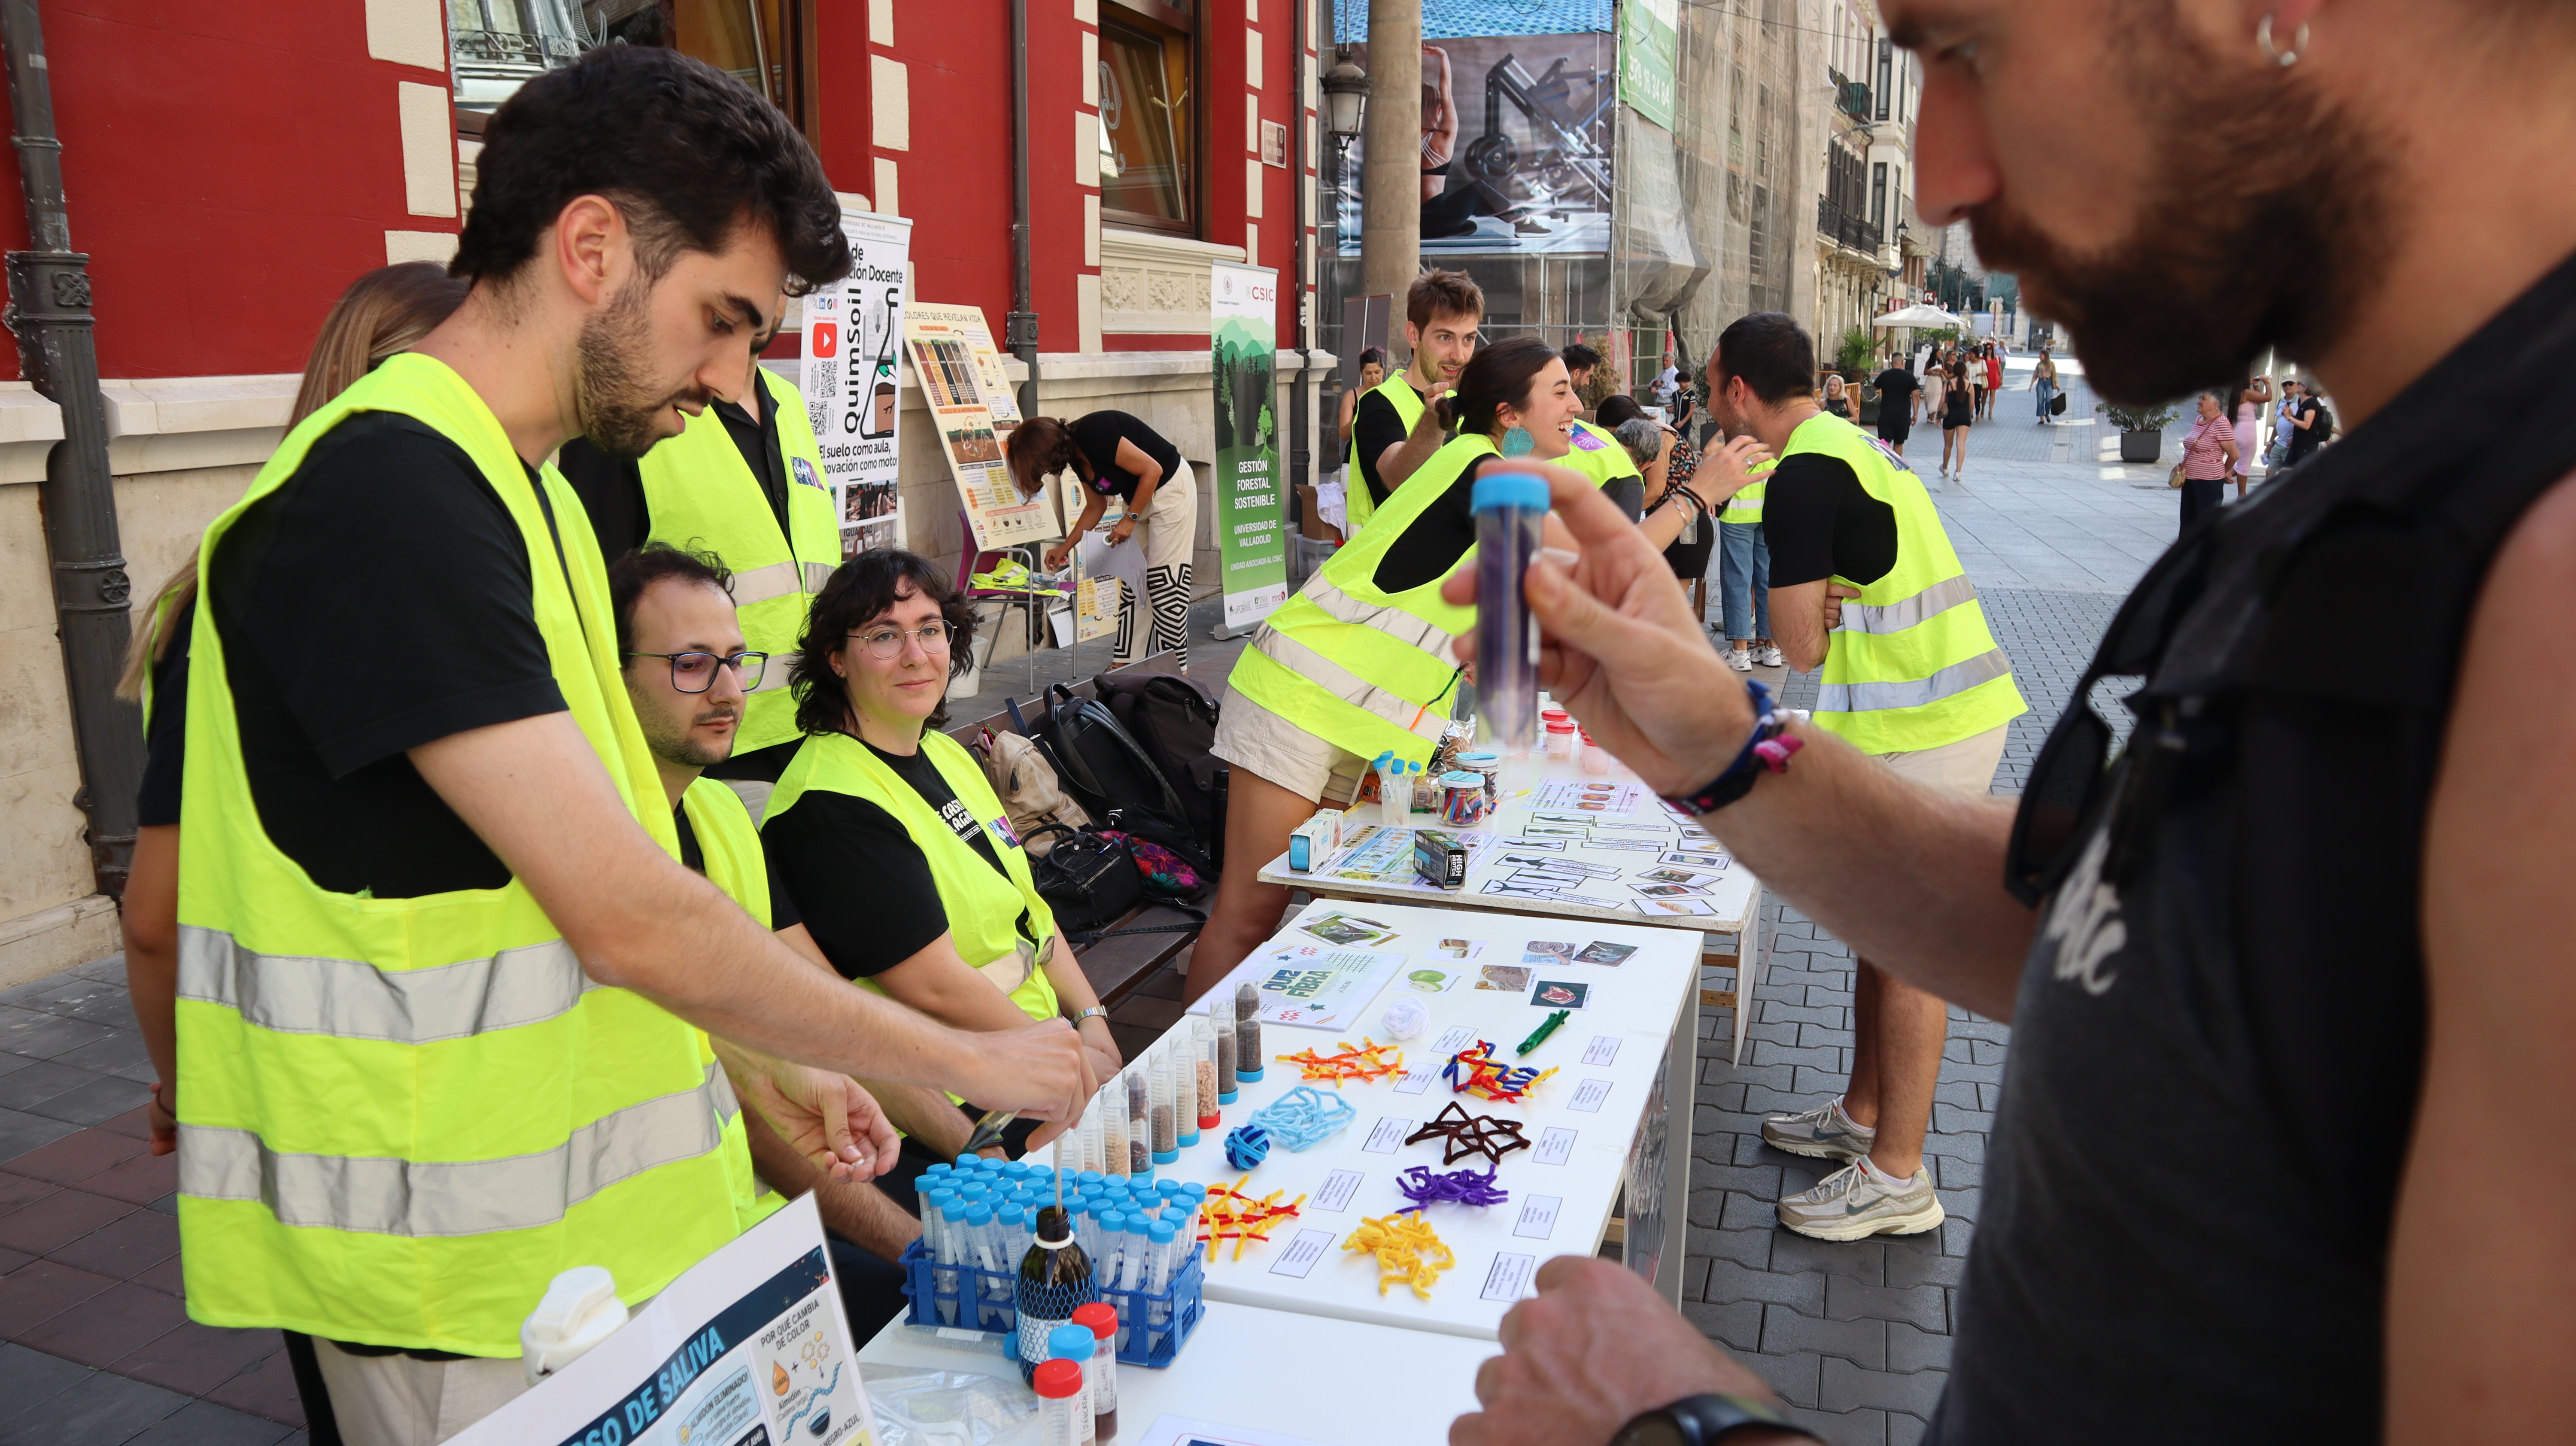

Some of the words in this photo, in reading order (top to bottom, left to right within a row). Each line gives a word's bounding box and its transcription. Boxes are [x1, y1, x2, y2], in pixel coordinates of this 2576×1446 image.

[1652, 74, 1660, 102] 34
[1662, 81, 1670, 109] 84
[851, 243, 863, 261] de
[848, 263, 867, 280] ción
[869, 264, 902, 283] Docente
[1252, 286, 1274, 302] CSIC
[930, 312, 943, 322] QUE
[944, 313, 968, 322] REVELAN
[969, 315, 982, 323] VIDA
[844, 288, 861, 433] QuimSoil
[827, 443, 850, 458] suelo
[853, 446, 872, 456] como
[874, 439, 891, 454] aula,
[823, 459, 858, 474] novación
[860, 461, 877, 471] como
[878, 457, 898, 468] motor
[1239, 457, 1267, 474] GESTIÓN
[1237, 477, 1271, 492] FORESTAL
[1234, 493, 1276, 510] SOSTENIBLE
[844, 525, 872, 537] IGUADAD
[1234, 521, 1268, 535] UNIVERSIDAD
[1268, 519, 1277, 529] DE
[1239, 534, 1271, 547] VALLADOLID
[1230, 561, 1245, 571] UNIDAD
[1245, 557, 1267, 569] ASOCIADA
[1272, 554, 1283, 563] CSIC
[1261, 969, 1303, 991] QUIZ
[1285, 970, 1333, 998] FIBRA
[760, 1331, 776, 1348] POR
[777, 1318, 792, 1337] QUÉ
[792, 1299, 820, 1324] CAMBIA
[776, 1337, 786, 1351] DE
[786, 1319, 811, 1344] COLOR
[624, 1385, 659, 1436] DE
[658, 1326, 726, 1405] SALIVA
[774, 1375, 789, 1391] LUGOL
[1101, 1364, 1109, 1392] BILIARES
[689, 1400, 714, 1434] ¡ALMIDÓN
[714, 1373, 749, 1405] ELIMINADO!
[706, 1417, 714, 1426] La
[713, 1403, 726, 1422] saliva
[725, 1393, 741, 1412] fuerte
[776, 1403, 796, 1424] (Cadena
[795, 1392, 809, 1411] larga)
[778, 1388, 802, 1412] Almidón
[705, 1416, 726, 1440] desintegra
[725, 1411, 731, 1419] el
[731, 1397, 753, 1417] almidón.
[712, 1422, 733, 1445] (Solución
[732, 1410, 749, 1428] Clara)
[823, 1414, 860, 1446] NEGRO-AZUL
